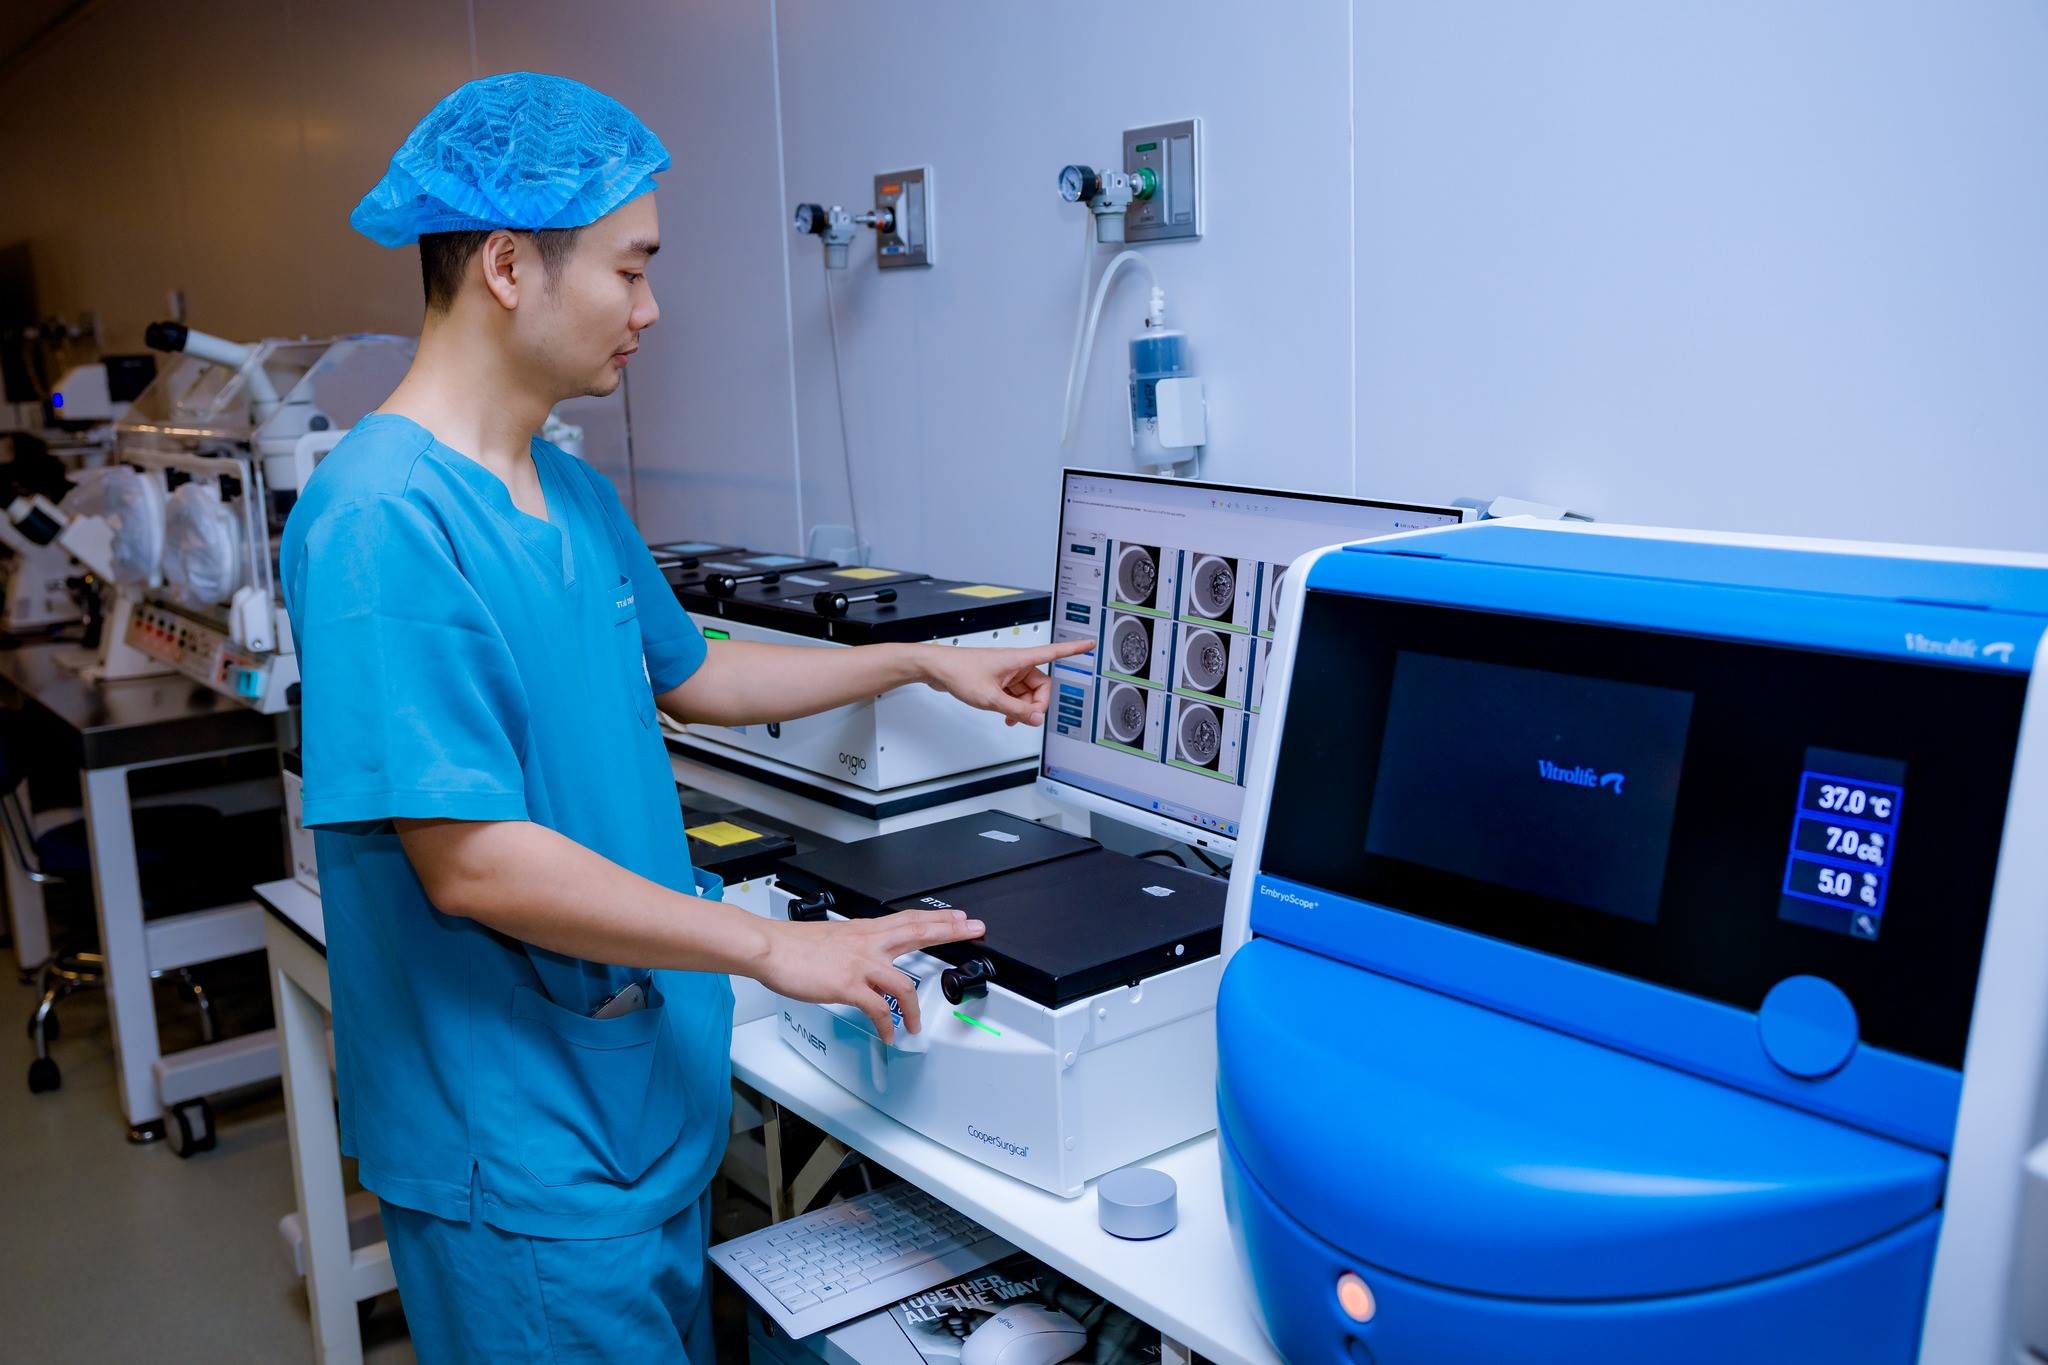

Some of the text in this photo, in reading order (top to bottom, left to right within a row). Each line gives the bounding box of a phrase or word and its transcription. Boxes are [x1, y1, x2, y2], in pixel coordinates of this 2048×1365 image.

[1539, 759, 1598, 787] Vitrolife
[1818, 784, 1866, 814] 37.0
[1826, 826, 1860, 855] 7.0
[1817, 868, 1852, 897] 5.0
[784, 1011, 827, 1056] PLANER
[904, 1304, 948, 1325] ALL
[948, 1291, 993, 1312] THE
